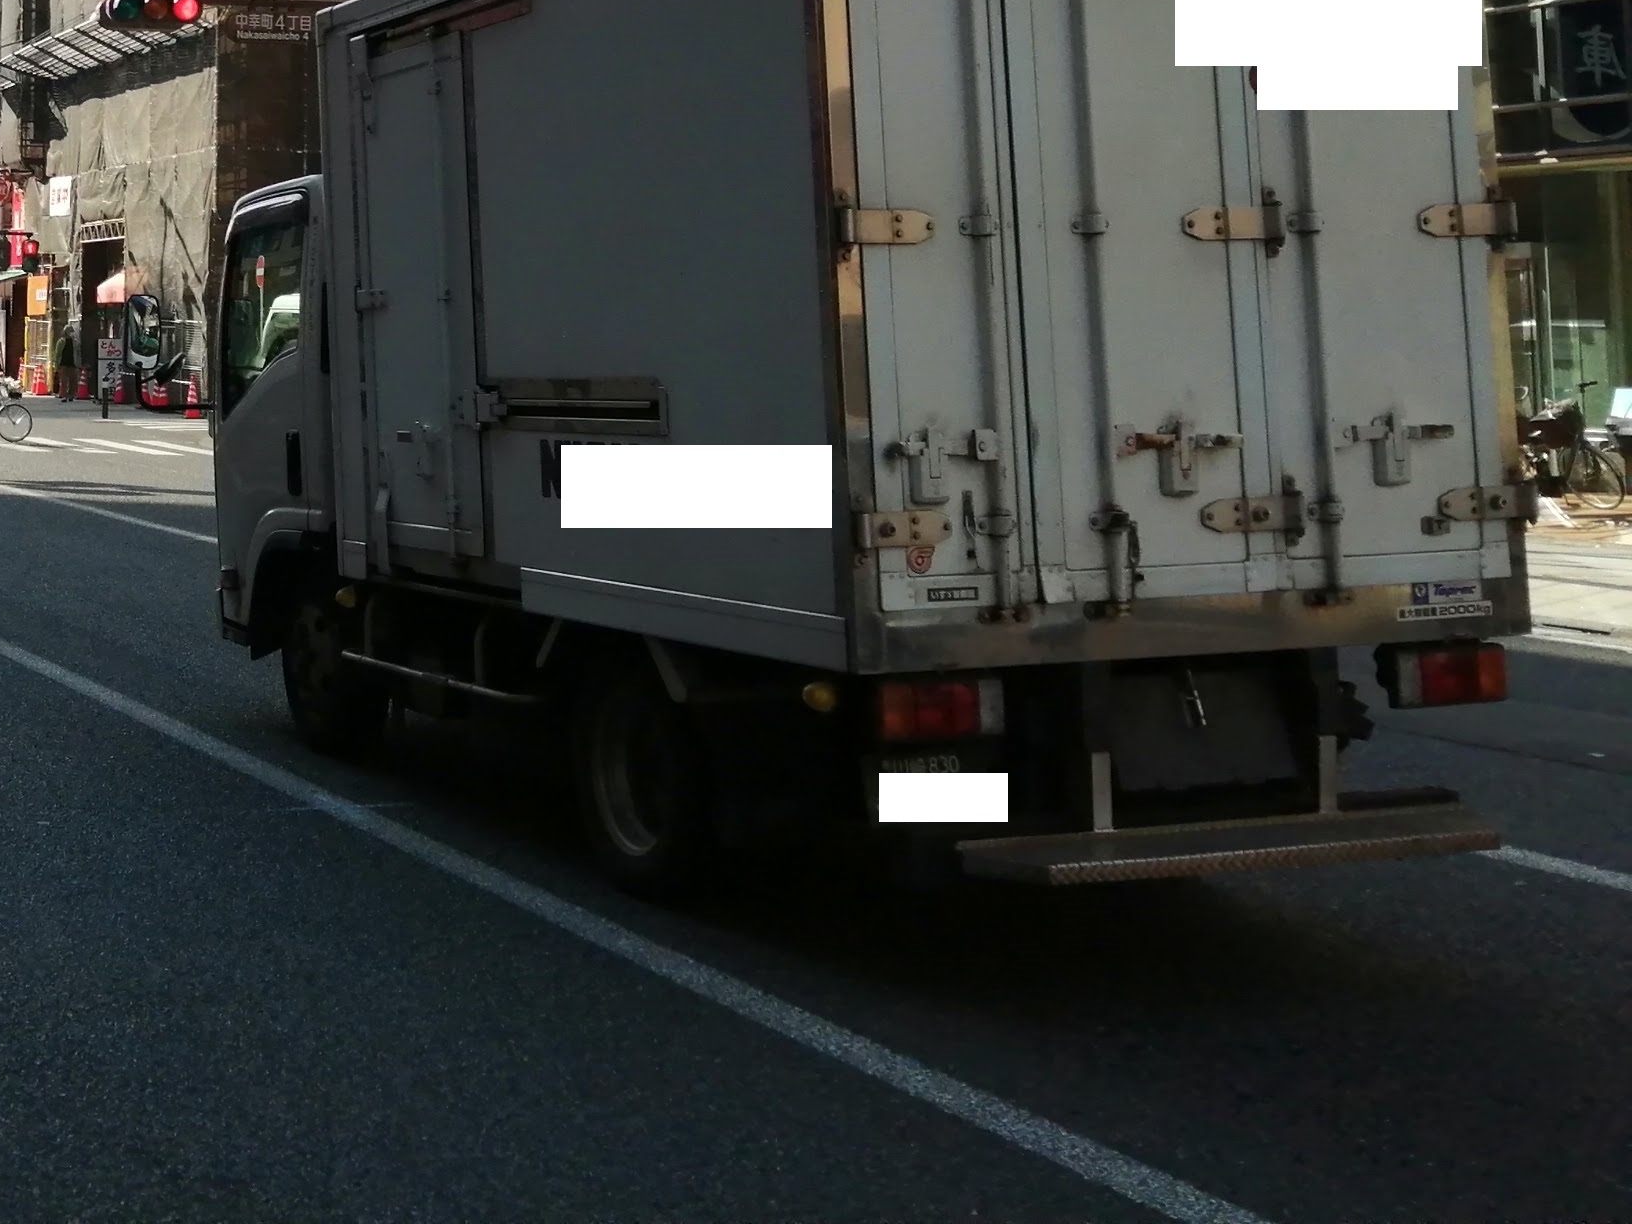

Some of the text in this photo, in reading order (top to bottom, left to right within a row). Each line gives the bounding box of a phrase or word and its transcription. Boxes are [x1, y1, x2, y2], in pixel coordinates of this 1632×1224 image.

[235, 13, 312, 31] 中幸町4丁目
[302, 32, 309, 40] 4
